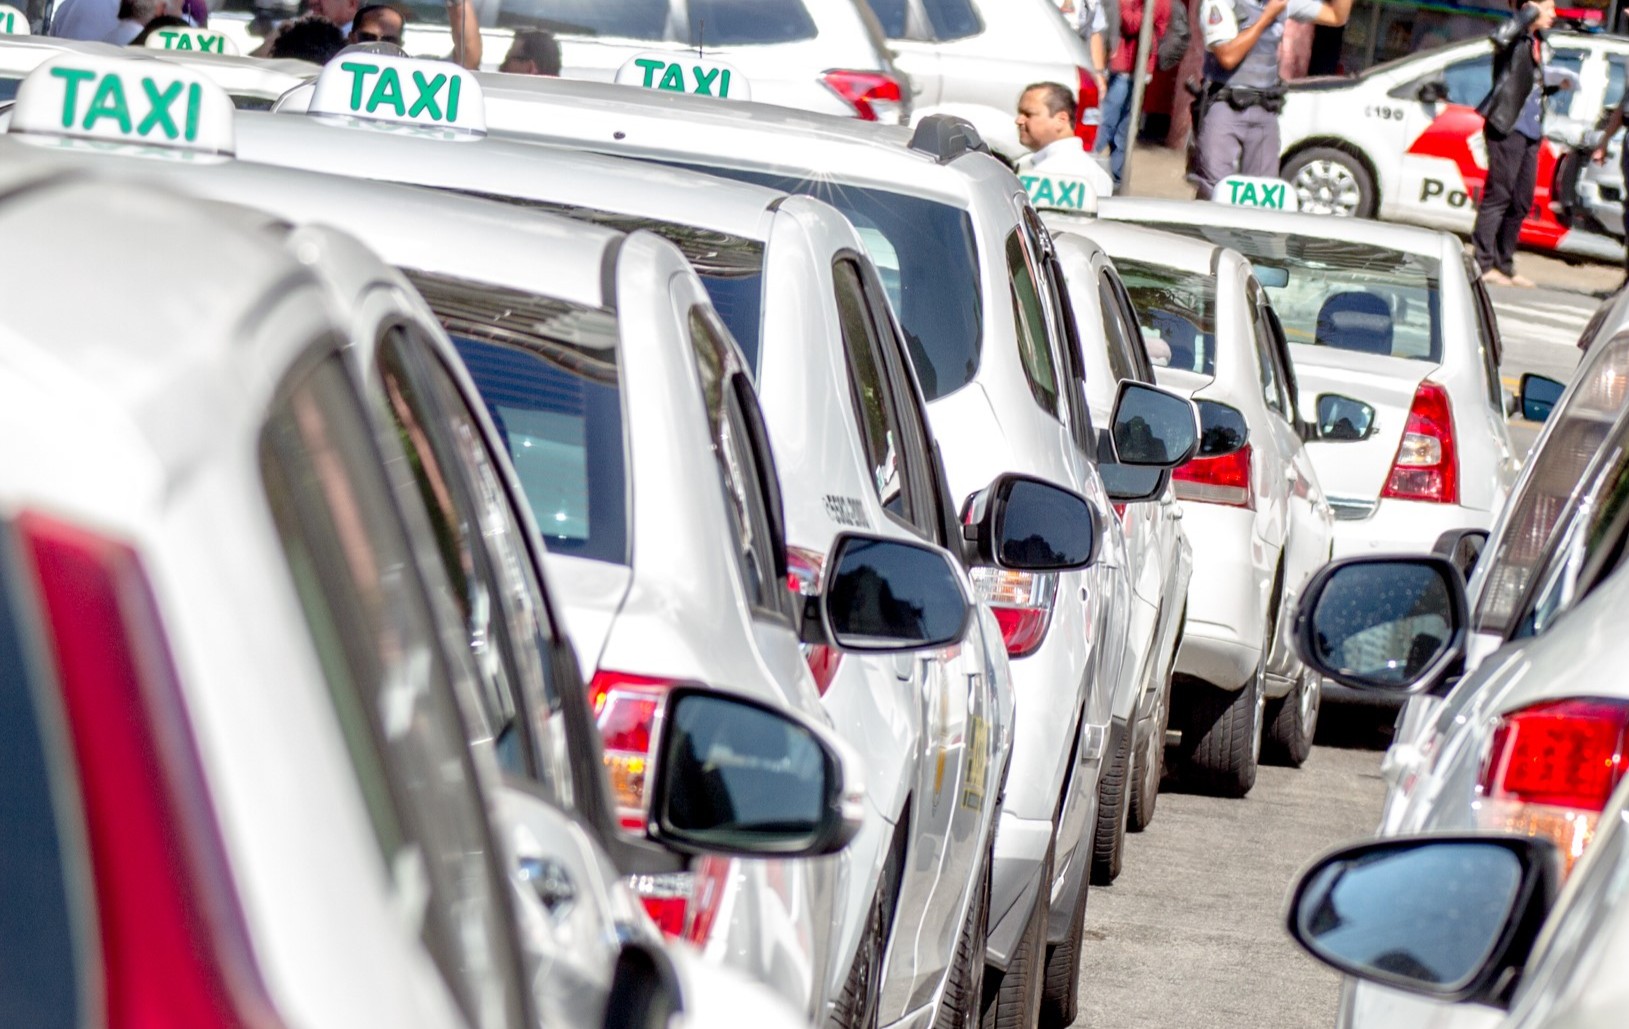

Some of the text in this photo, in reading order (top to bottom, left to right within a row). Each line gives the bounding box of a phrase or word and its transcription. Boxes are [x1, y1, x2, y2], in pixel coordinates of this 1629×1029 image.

[159, 31, 225, 54] TAXI
[340, 61, 462, 123] TAXI
[634, 58, 731, 99] TAXI
[50, 66, 203, 142] TAXI
[1020, 175, 1086, 209] TAXI
[1226, 180, 1286, 210] TAXI
[1420, 177, 1483, 210] Pol
